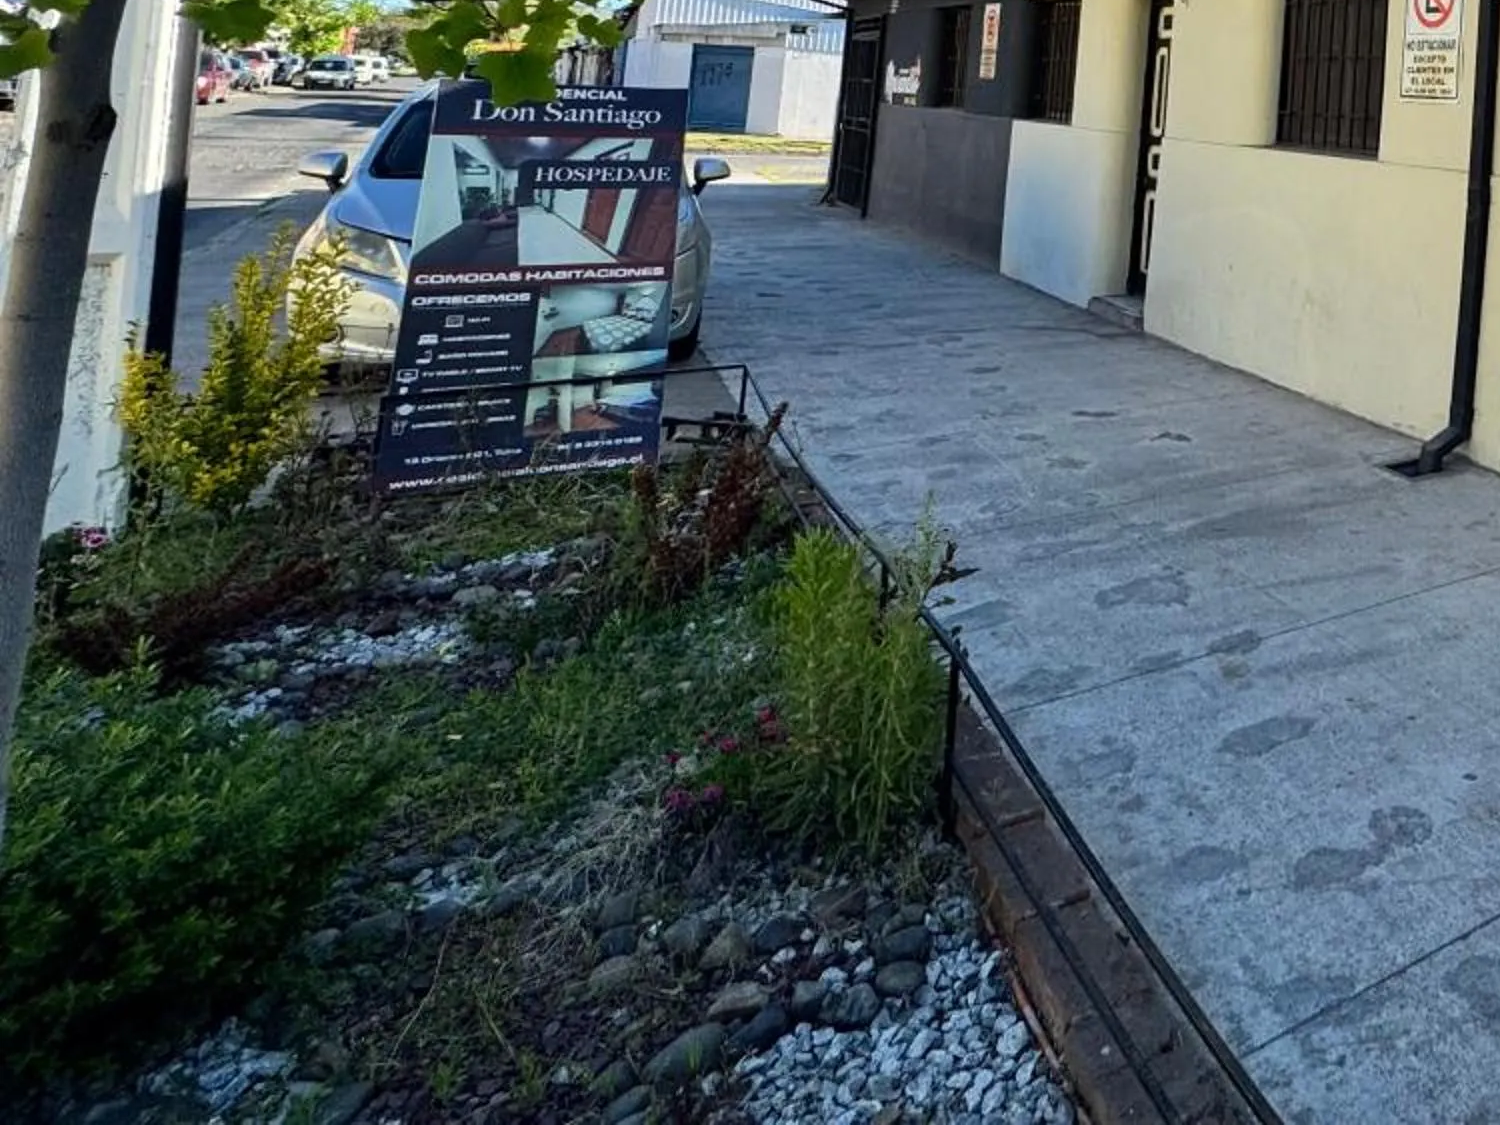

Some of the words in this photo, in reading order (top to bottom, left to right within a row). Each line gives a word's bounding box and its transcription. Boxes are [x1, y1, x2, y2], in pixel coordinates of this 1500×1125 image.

[472, 99, 535, 122] Don
[543, 101, 662, 130] Santiago
[535, 166, 672, 183] HOSPEDAJE
[414, 271, 522, 285] COMODAS
[525, 266, 666, 282] HABITACIONES
[411, 292, 532, 306] OFRECEMOS
